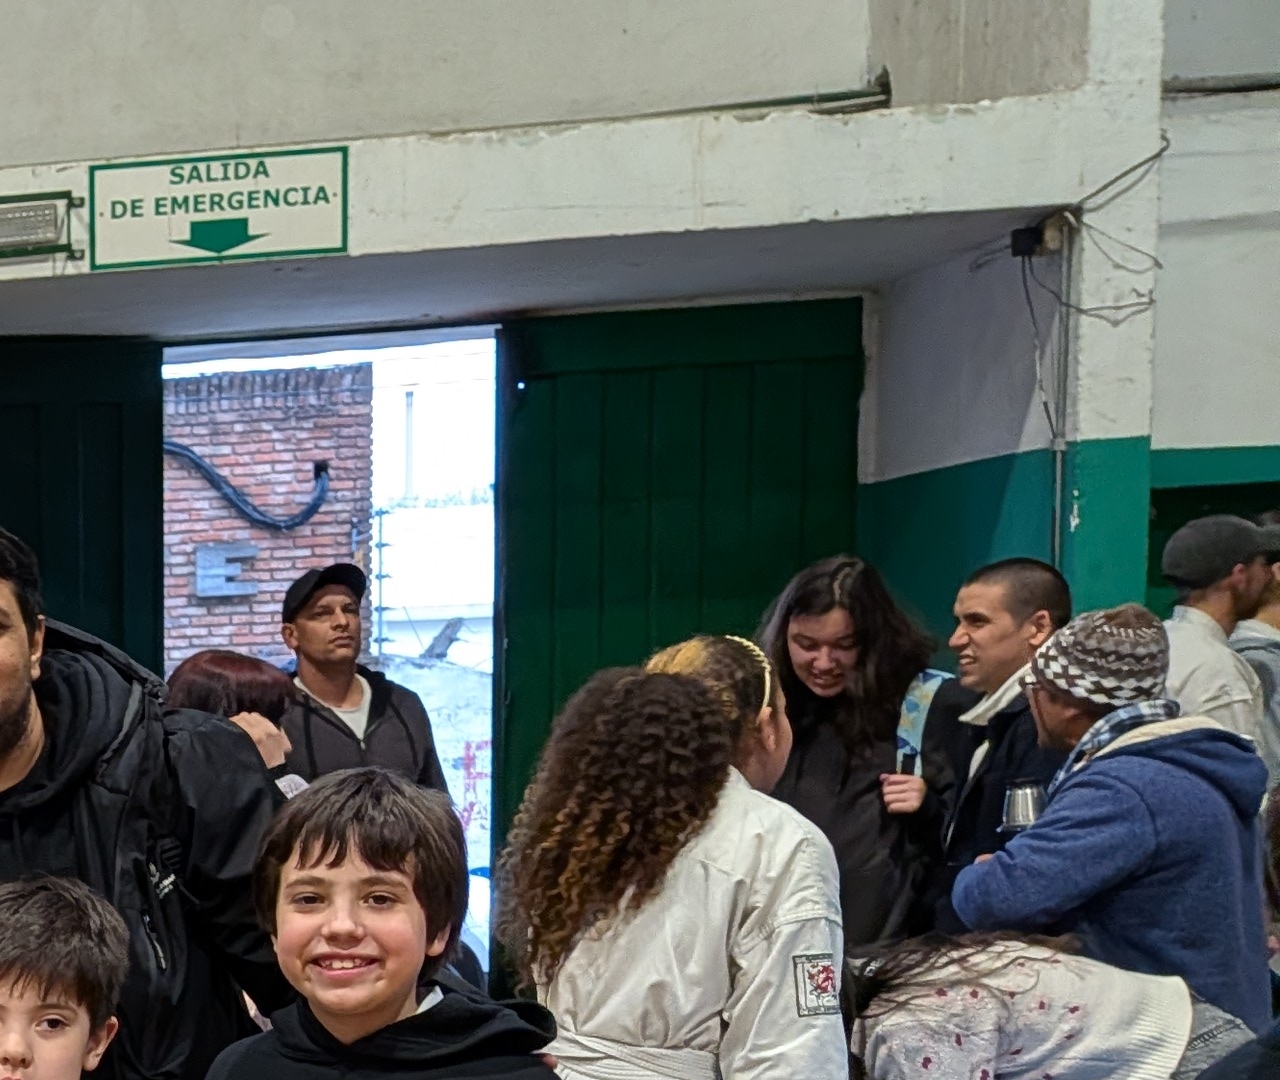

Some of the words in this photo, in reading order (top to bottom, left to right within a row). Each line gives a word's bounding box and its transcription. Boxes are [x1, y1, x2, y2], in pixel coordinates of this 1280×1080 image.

[169, 160, 270, 185] SALIDA
[110, 199, 144, 220] DE
[154, 185, 330, 216] EMERGENCIA
